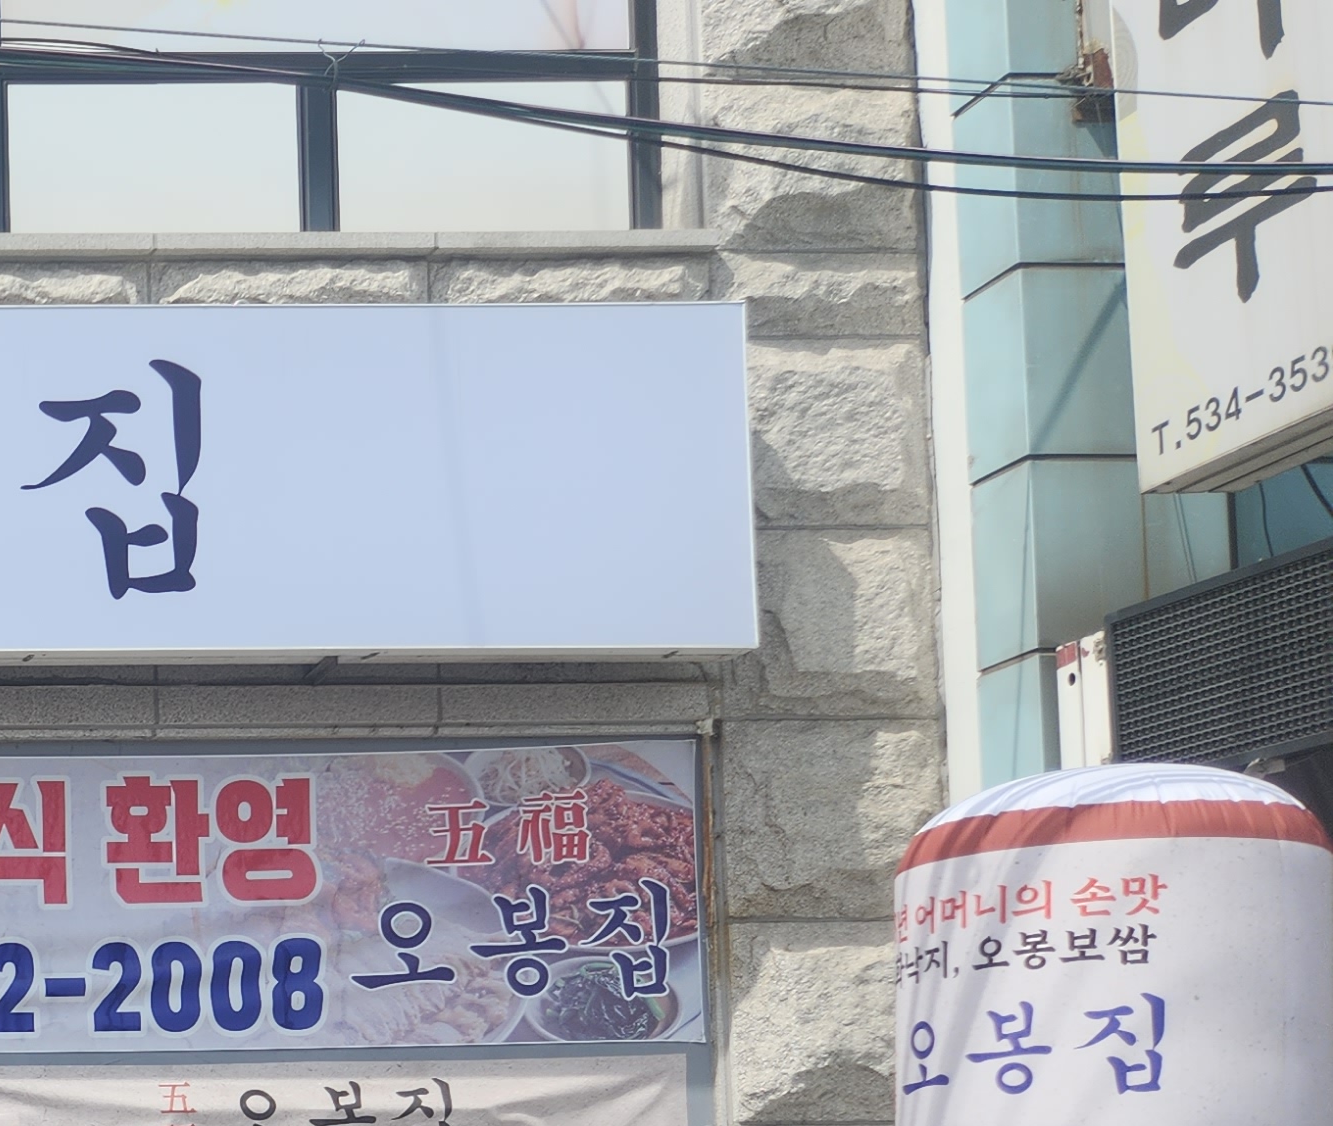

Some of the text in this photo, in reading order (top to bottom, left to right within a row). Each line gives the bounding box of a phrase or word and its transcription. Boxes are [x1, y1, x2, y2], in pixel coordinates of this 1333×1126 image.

[1151, 346, 1333, 455] T.534-353
[105, 776, 318, 904] 환영
[426, 788, 590, 867] 五福
[349, 878, 671, 999] 오봉집
[915, 879, 1052, 934] 어머니의
[1070, 873, 1169, 917] 손맛
[972, 923, 1157, 970] 오봉보쌈
[902, 992, 1165, 1095] 오봉집
